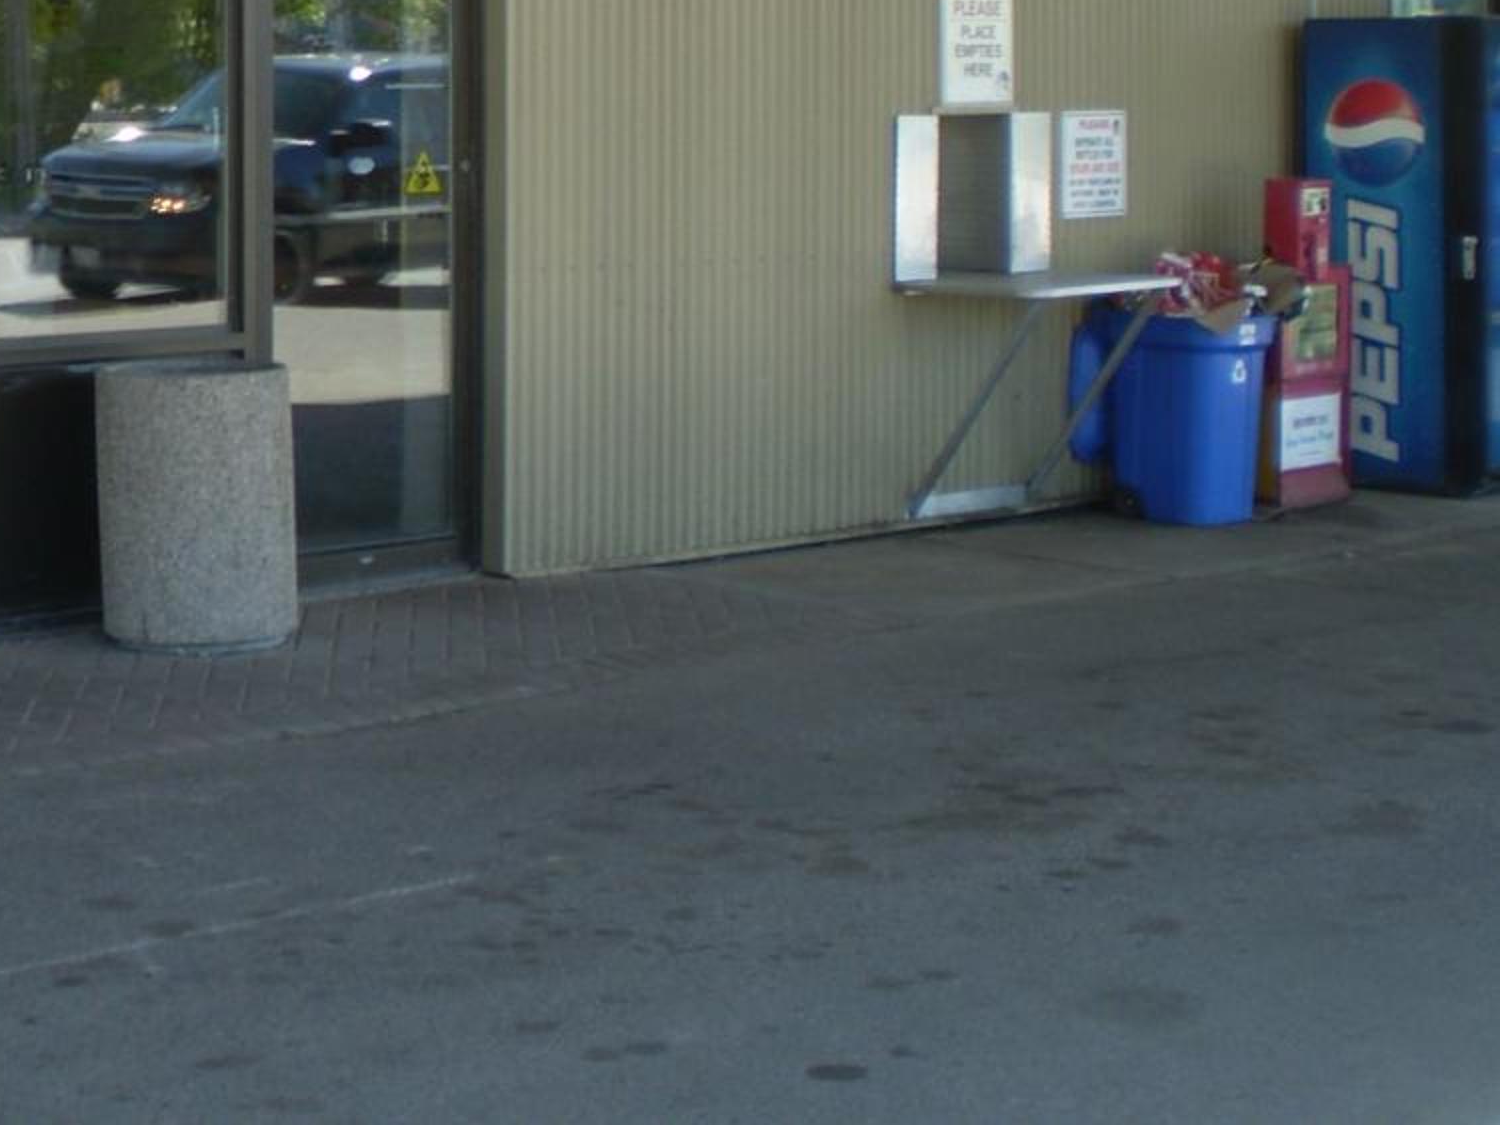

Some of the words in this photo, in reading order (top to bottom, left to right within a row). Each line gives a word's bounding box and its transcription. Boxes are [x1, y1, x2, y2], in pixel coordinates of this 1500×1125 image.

[953, 0, 1002, 17] PLEASE
[961, 25, 997, 40] PLACE
[963, 62, 994, 77] HERE
[1347, 200, 1400, 463] PEPSI
